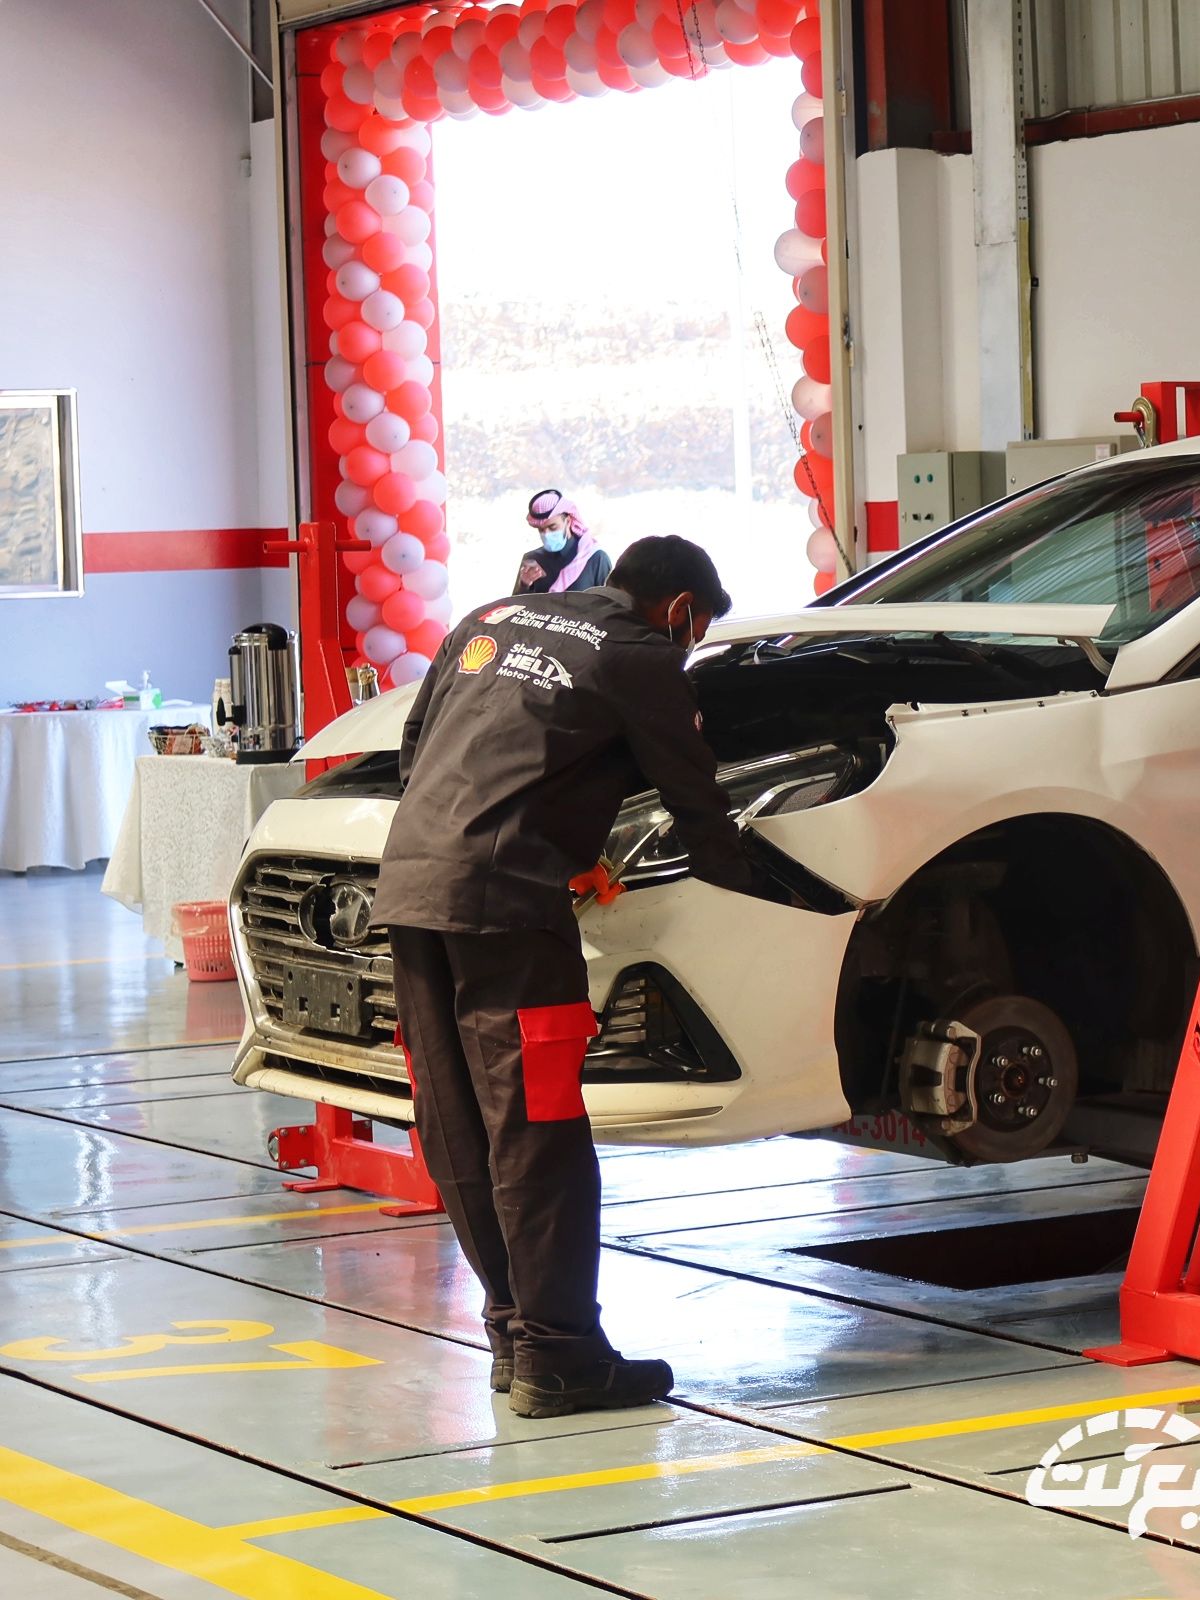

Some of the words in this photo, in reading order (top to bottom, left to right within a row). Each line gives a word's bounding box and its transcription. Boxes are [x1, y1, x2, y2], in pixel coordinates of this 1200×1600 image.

[545, 622, 603, 646] MAINTENANCE
[510, 643, 543, 657] Shell
[496, 666, 531, 681] Motor
[532, 678, 554, 690] oils
[502, 653, 573, 690] HELIX
